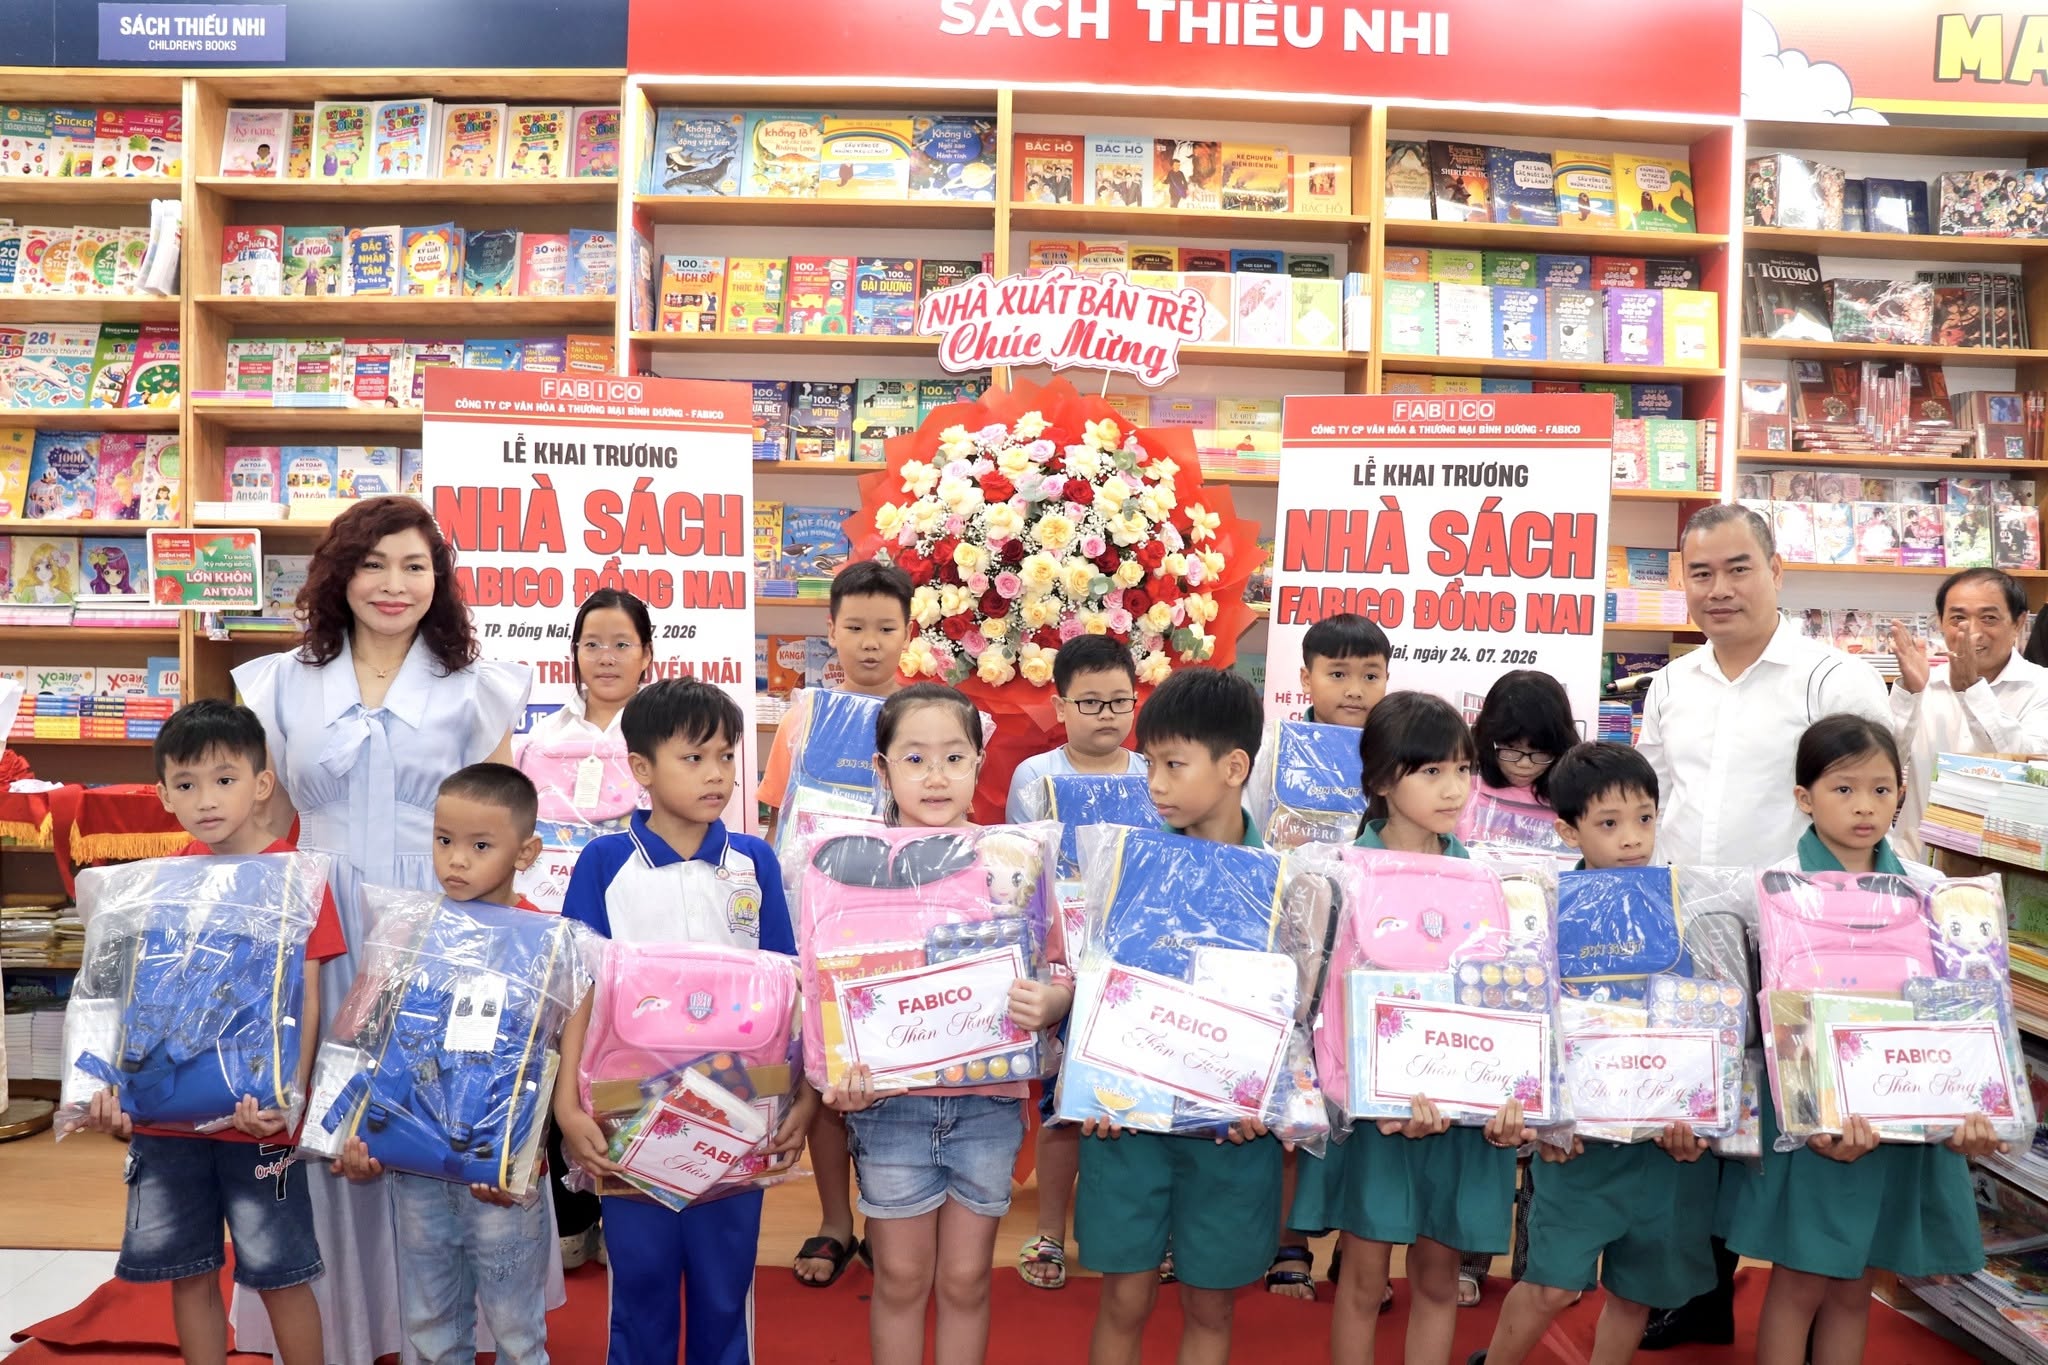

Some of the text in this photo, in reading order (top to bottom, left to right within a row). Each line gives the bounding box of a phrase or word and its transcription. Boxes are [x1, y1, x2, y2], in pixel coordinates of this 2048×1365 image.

[120, 14, 265, 36] SÁCH THIẾU NHI
[1343, 9, 1449, 56] NHI
[149, 40, 236, 51] CHILDREN'S BOOKS
[1934, 14, 2048, 85] MA
[55, 115, 93, 127] STICKER
[765, 126, 796, 138] khổng
[933, 128, 961, 139] Khổng
[1025, 141, 1073, 152] BÁC HỒ
[1096, 142, 1143, 154] BÁC HỒ
[1441, 168, 1477, 177] SHERLOCK
[361, 238, 382, 251] ĐẮC
[592, 235, 604, 243] 30
[359, 252, 386, 263] NHÂN
[535, 245, 549, 255] 30
[362, 264, 382, 275] TÂM
[678, 260, 697, 268] 100
[795, 263, 814, 271] 100
[939, 265, 955, 273] 100
[675, 271, 714, 284] LỊCH SỬ
[1758, 263, 1818, 282] TOTORO
[861, 277, 912, 293] ĐẠI DƯƠNG
[927, 272, 1198, 335] NHÀ XUẤT BẢN TRẺ
[28, 332, 56, 345] 281
[949, 318, 1169, 378] Chúc Mừng
[544, 382, 641, 400] FABICO
[754, 388, 773, 397] 100
[922, 386, 944, 395] 100
[456, 399, 479, 409] CÔNG
[483, 402, 496, 410] TY
[499, 402, 512, 411] CP
[514, 401, 534, 411] VĂN
[536, 402, 556, 412] HÓA
[558, 405, 565, 413] &
[567, 404, 605, 414] THƯƠNG
[607, 406, 625, 417] MẠI
[628, 406, 649, 416] BÌNH
[652, 408, 683, 418] DƯƠNG
[691, 410, 724, 419] FABICO
[1397, 403, 1493, 418] FABICO
[1311, 424, 1335, 435] CÔNG
[1338, 426, 1349, 434] TY
[1352, 426, 1364, 434] CP
[1367, 424, 1385, 434] VĂN
[1387, 424, 1407, 434] HÓA
[1409, 426, 1416, 434] &
[1419, 424, 1455, 434] THƯƠNG
[1458, 425, 1476, 437] MẠI
[1479, 424, 1501, 434] BÌNH
[1505, 424, 1537, 434] DƯƠNG
[1546, 425, 1580, 435] FABICO
[59, 453, 84, 463] 1000
[503, 433, 678, 468] LỄ KHAI TRƯƠNG
[1354, 456, 1529, 488] LỄ KHAI TRƯƠNG
[433, 473, 744, 556] NHÀ SÁCH
[1282, 495, 1598, 579] NHÀ SÁCH
[186, 569, 252, 583] LỚN KHÔN
[203, 586, 253, 597] AN TOÀN
[454, 566, 563, 608] ABICO
[683, 570, 746, 610] NAI
[1413, 578, 1517, 633] ĐỒNG
[1525, 592, 1595, 635] NAI
[484, 623, 502, 638] TP.
[507, 621, 541, 641] Đồng
[546, 624, 571, 640] Nai,
[663, 625, 696, 639] 2026
[1413, 647, 1446, 664] ngày
[1450, 647, 1471, 663] 24.
[1476, 648, 1496, 664] 07.
[1501, 648, 1538, 665] 2026
[536, 653, 741, 684] TRÌ UYẾN MÃI
[1275, 690, 1292, 706] HỆ
[1289, 824, 1336, 840] WATERC
[898, 986, 972, 1015] FABICO
[886, 1002, 996, 1048] Thân Tặng
[1150, 1005, 1228, 1043] FABICO
[1122, 1027, 1176, 1058] Thân
[1425, 1030, 1494, 1052] FABICO
[1884, 1048, 1952, 1064] FABICO
[1465, 1057, 1513, 1090] Tặng
[1873, 1069, 1976, 1097] Thân Tặng
[693, 1140, 740, 1165] FABI
[255, 1156, 296, 1179] Origin
